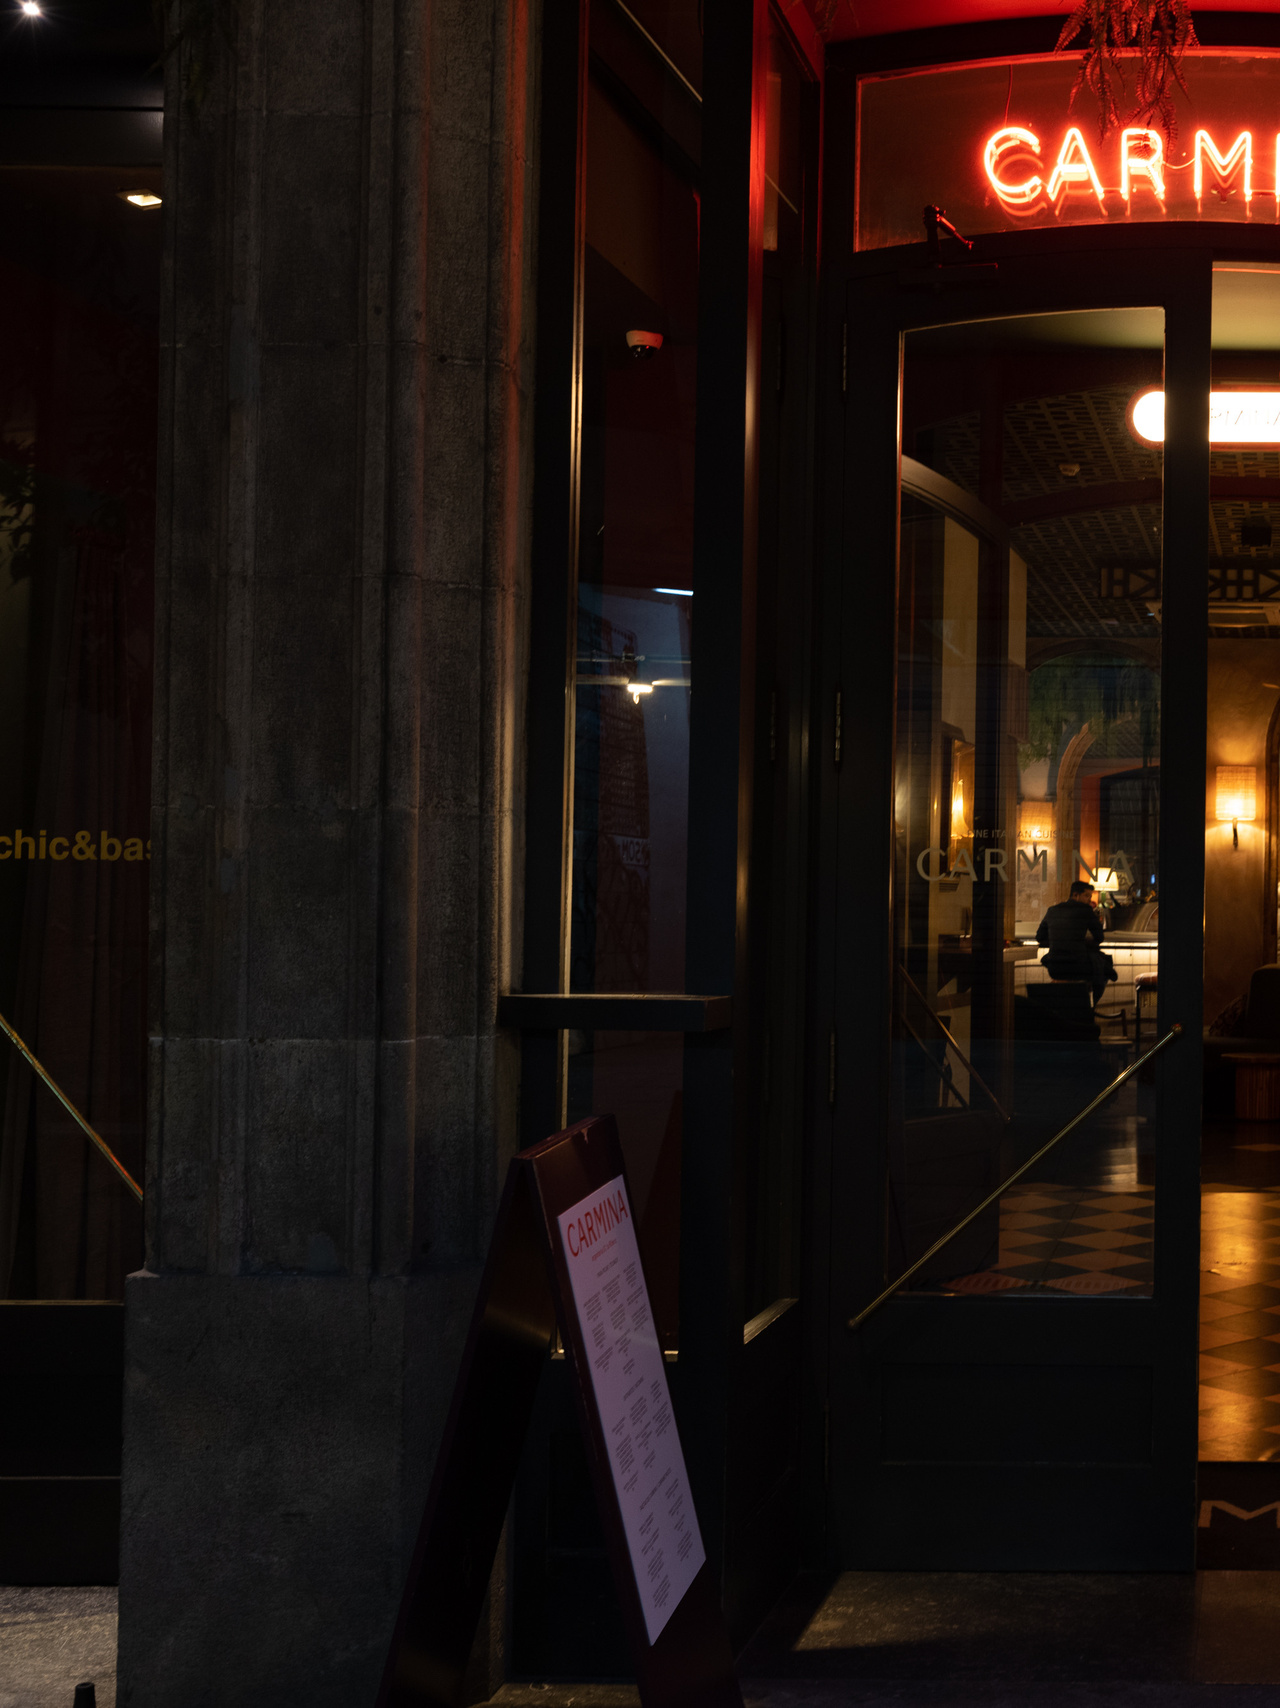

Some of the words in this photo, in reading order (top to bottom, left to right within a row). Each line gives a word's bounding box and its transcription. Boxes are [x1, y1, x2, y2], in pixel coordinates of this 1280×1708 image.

[0, 829, 151, 861] chic&ba
[916, 847, 1135, 884] CARMINA
[566, 1189, 629, 1258] CARMINA
